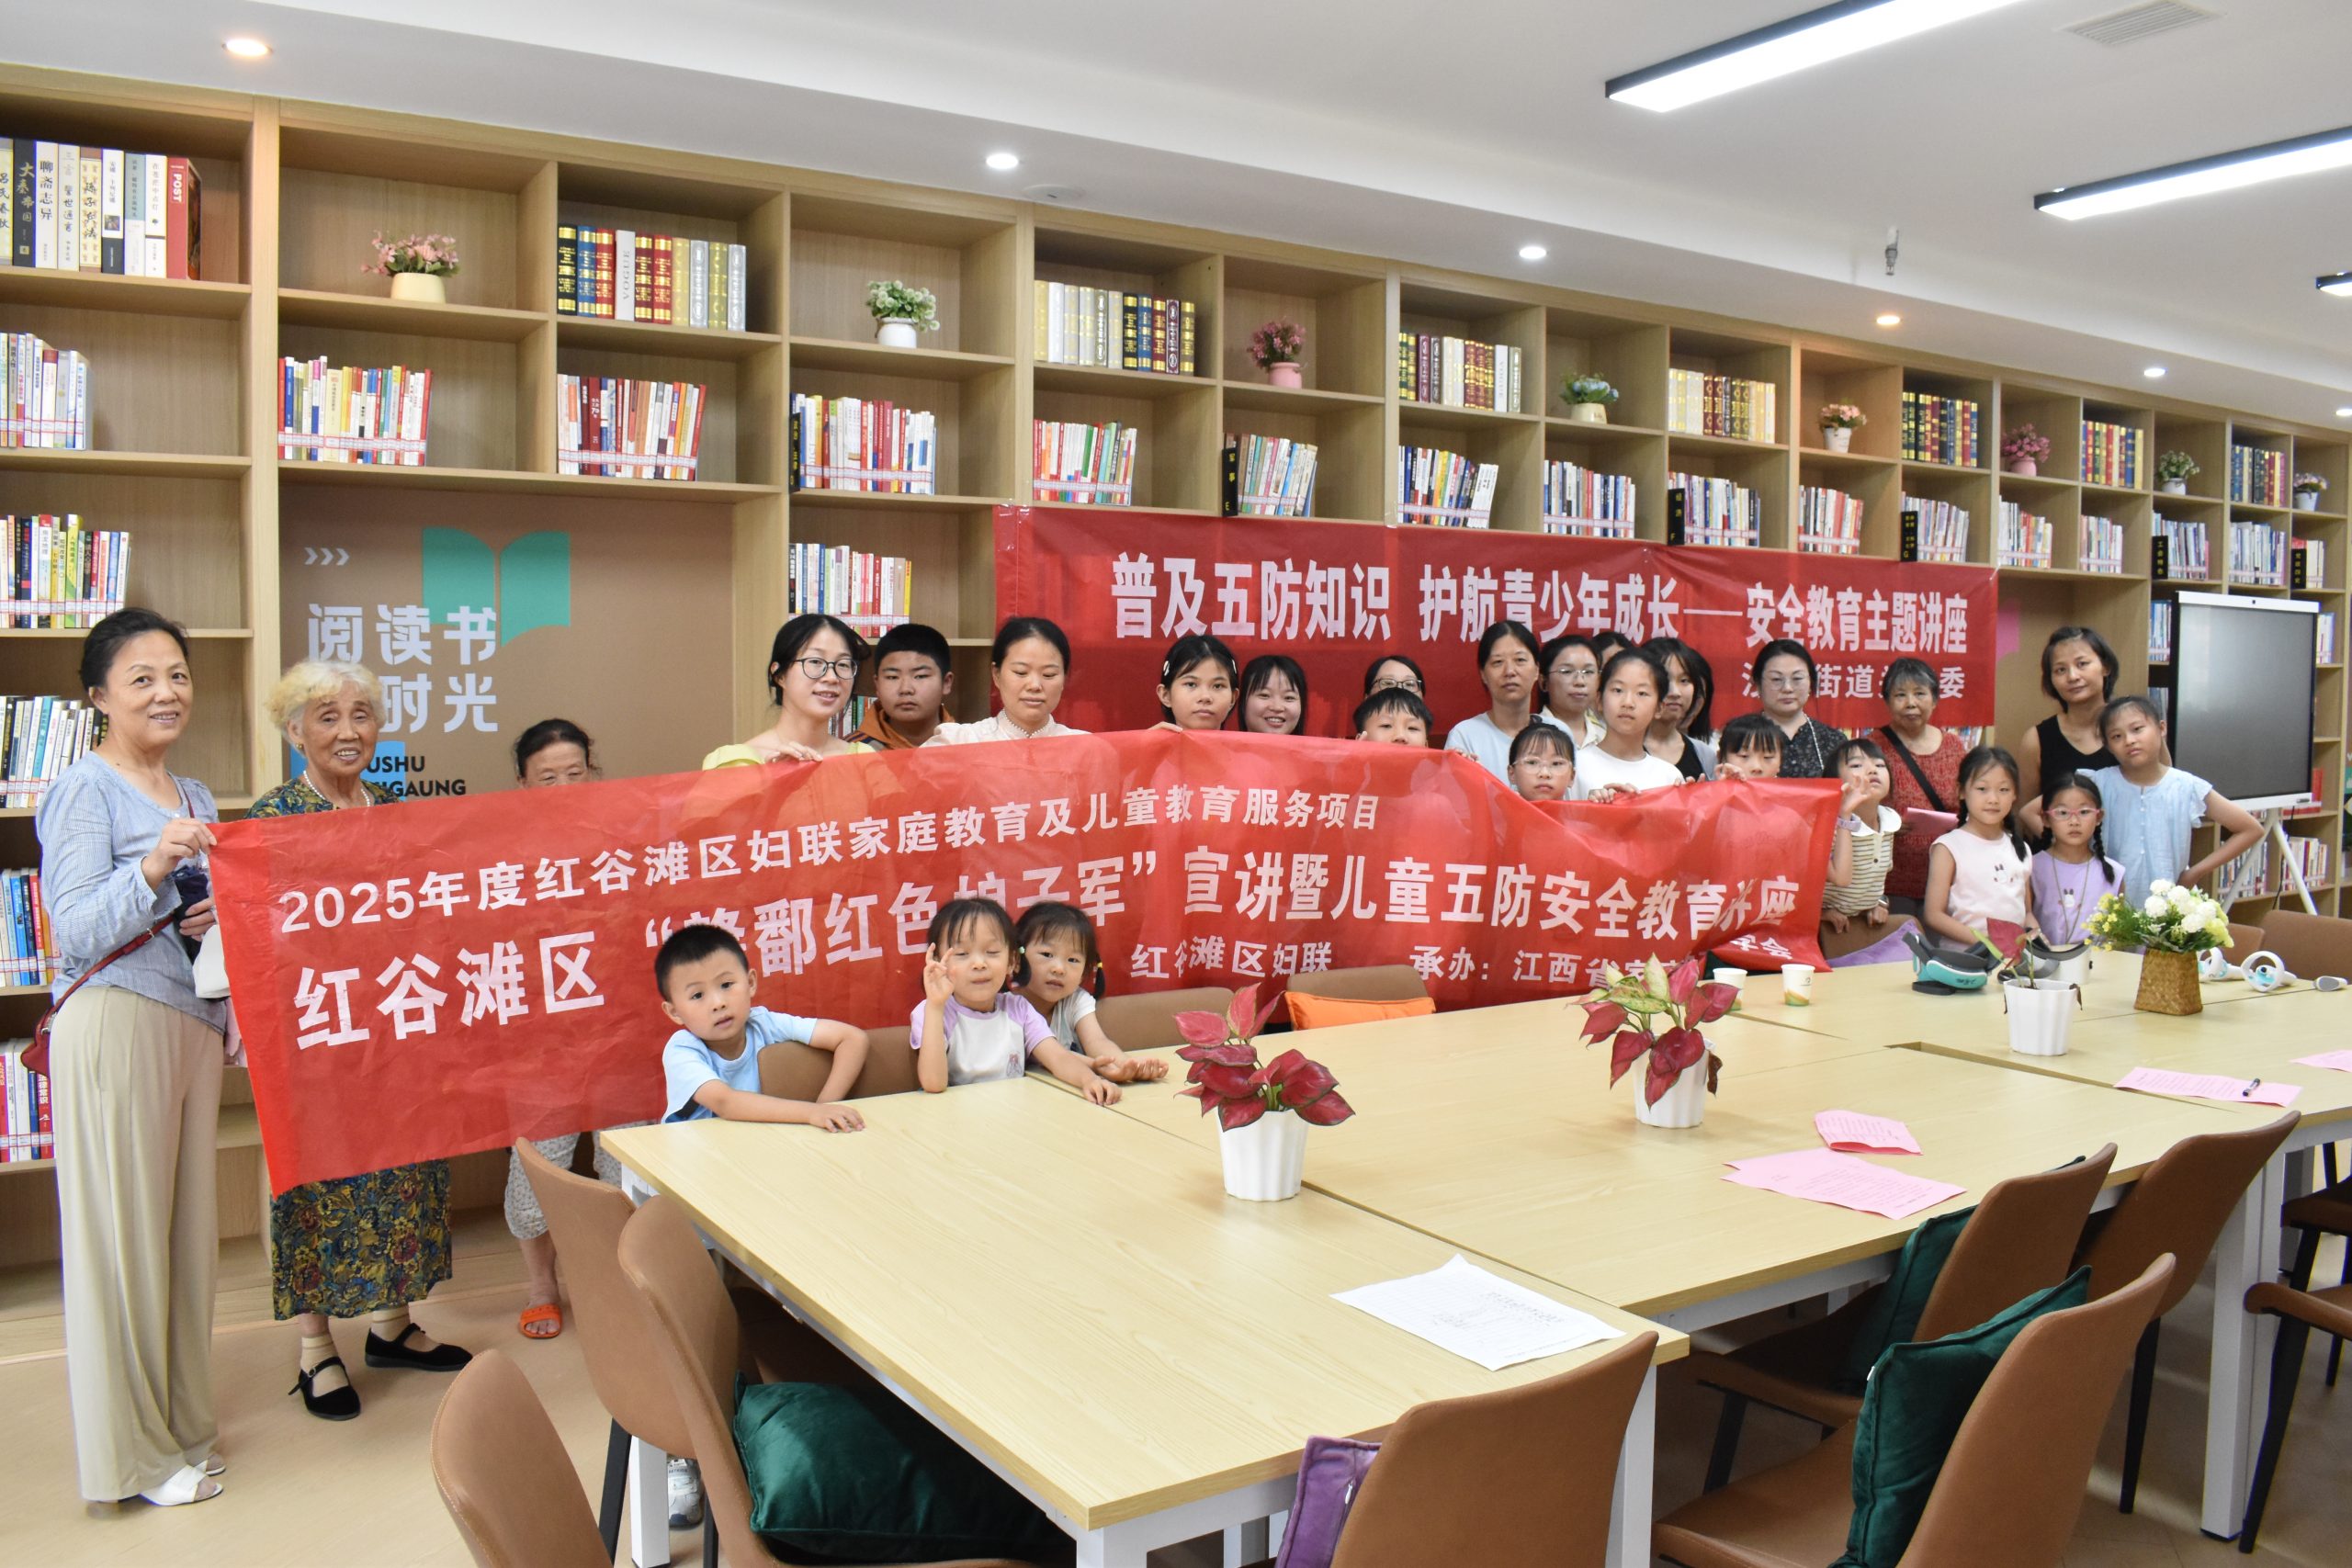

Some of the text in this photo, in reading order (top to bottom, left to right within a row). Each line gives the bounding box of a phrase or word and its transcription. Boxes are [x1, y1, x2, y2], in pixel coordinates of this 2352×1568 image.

[40, 160, 53, 220] 聊斋志异
[172, 173, 183, 203] POST
[1111, 551, 1391, 640] 普及五防知识
[308, 604, 497, 665] 阅读书
[375, 779, 467, 797] GAUNG
[279, 784, 1378, 933] 2025年度红谷滩区妇联家庭教育及儿童教育服务项目
[293, 931, 605, 1051] 红谷滩区
